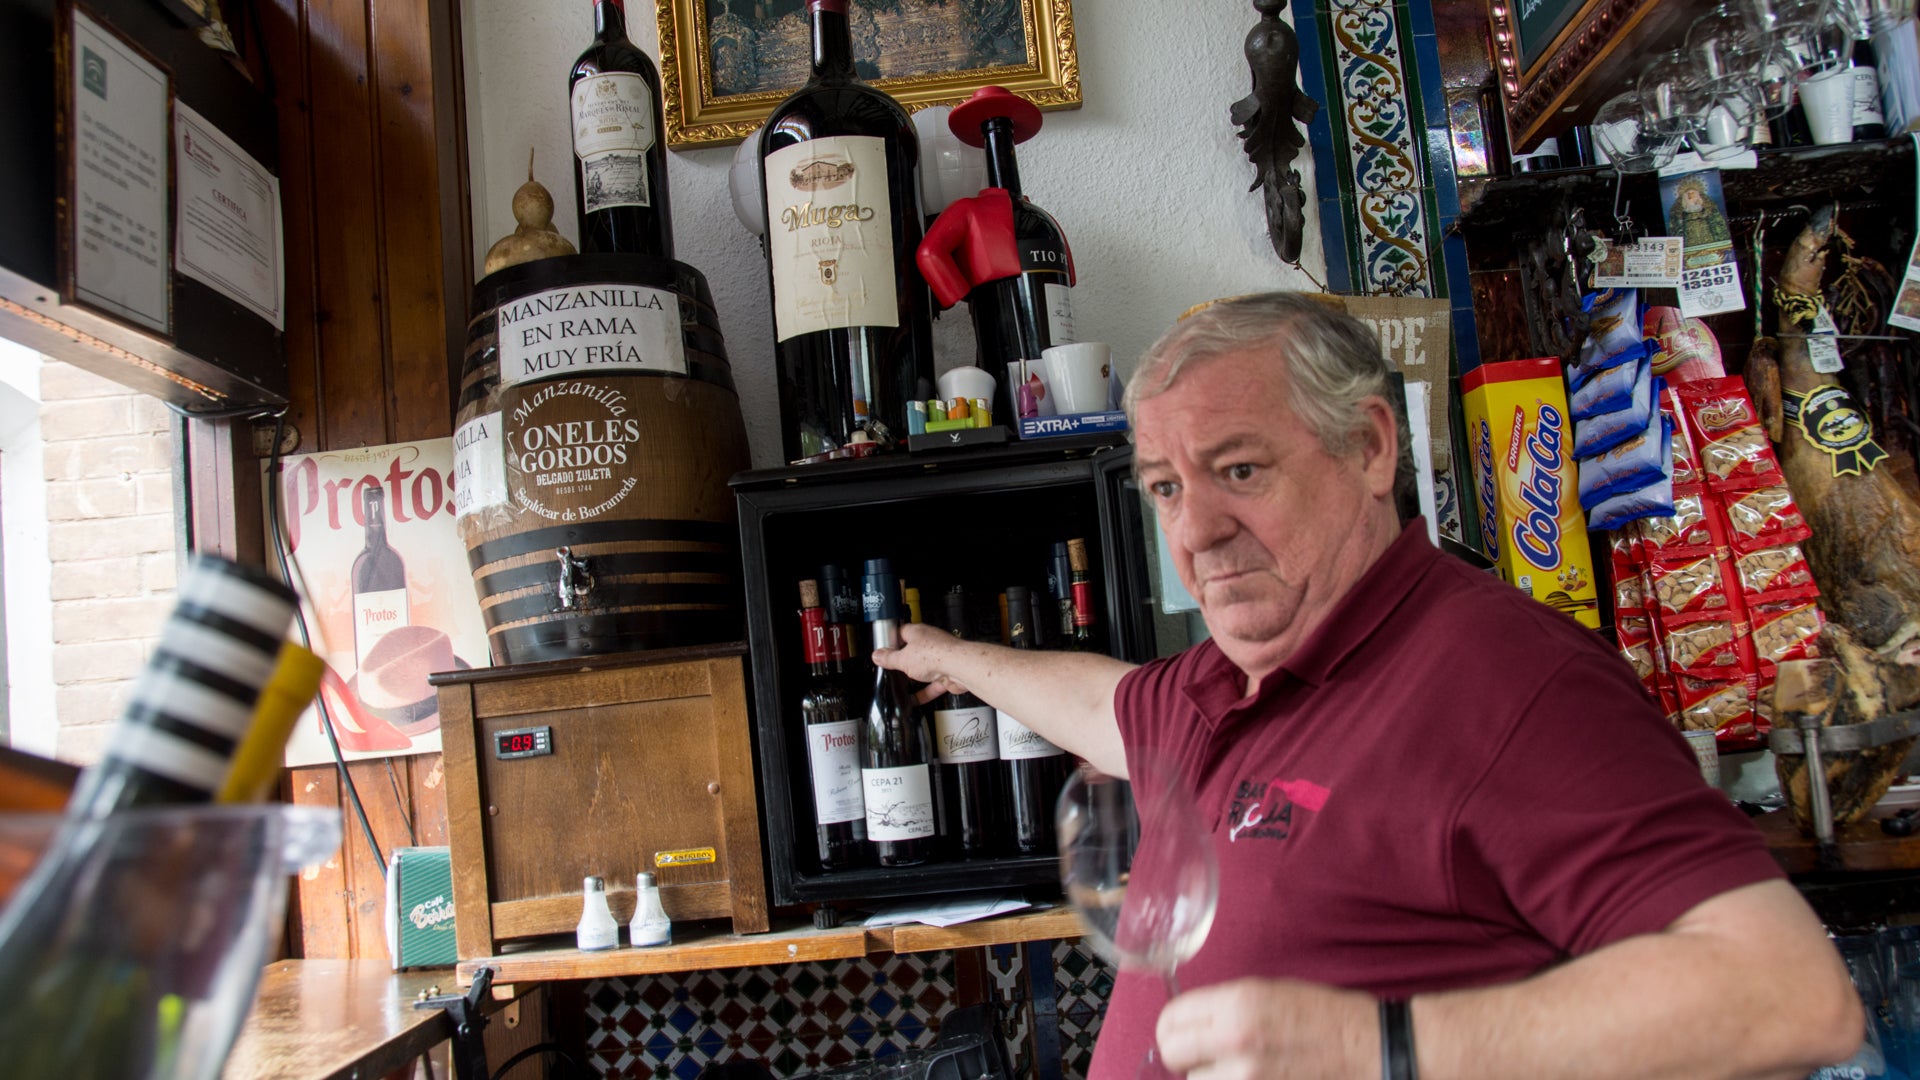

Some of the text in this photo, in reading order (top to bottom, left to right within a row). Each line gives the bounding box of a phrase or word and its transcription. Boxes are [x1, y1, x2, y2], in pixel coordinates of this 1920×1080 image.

[781, 201, 874, 232] Muga
[811, 235, 843, 248] RIOJA
[1030, 250, 1056, 262] TIO
[1681, 265, 1733, 282] 12415
[1681, 275, 1734, 291] 13397
[501, 289, 664, 328] MANZANILLA
[522, 317, 638, 348] EN RAMA
[523, 341, 643, 376] MUY FRÍA
[513, 381, 627, 427] Manzanilla
[523, 418, 640, 451] ONELES
[1508, 410, 1524, 468] ORIGINAL
[344, 448, 390, 464] DESDE 1927
[520, 443, 628, 473] GORDOS
[535, 467, 612, 486] DELGADO ZULETA
[556, 485, 592, 495] DESDE 1744
[1480, 419, 1500, 562] ColaCao
[1514, 403, 1563, 572] ColaCao
[515, 475, 638, 521] Sanlúcar de Barrameda
[363, 608, 398, 625] Protos
[822, 732, 856, 752] Protos
[871, 778, 891, 787] CEPA
[892, 776, 903, 786] 21
